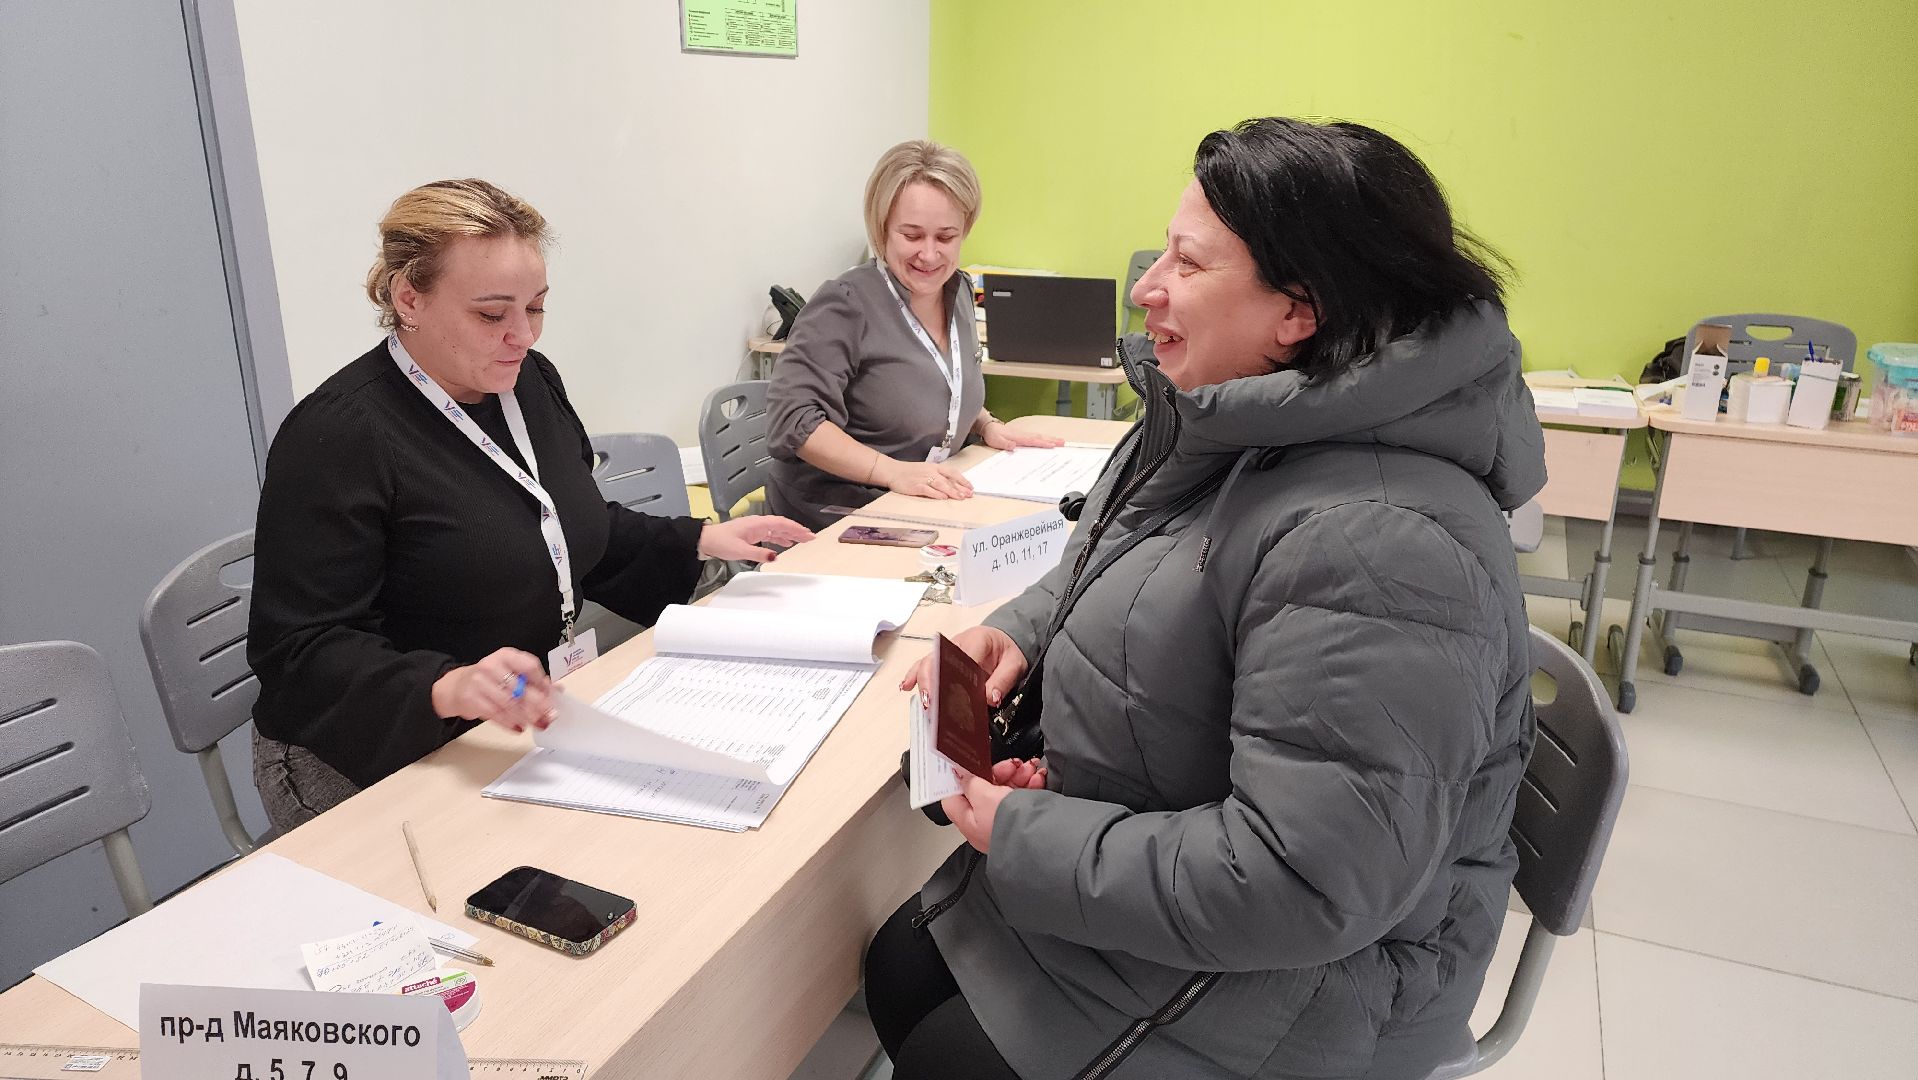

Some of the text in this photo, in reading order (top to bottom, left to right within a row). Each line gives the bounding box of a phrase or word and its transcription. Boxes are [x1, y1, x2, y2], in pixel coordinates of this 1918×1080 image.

[972, 519, 1064, 557] ул. Оранжерейная
[991, 541, 1048, 572] д. 10, 11, 17
[160, 1010, 421, 1047] пр-д Маяковского
